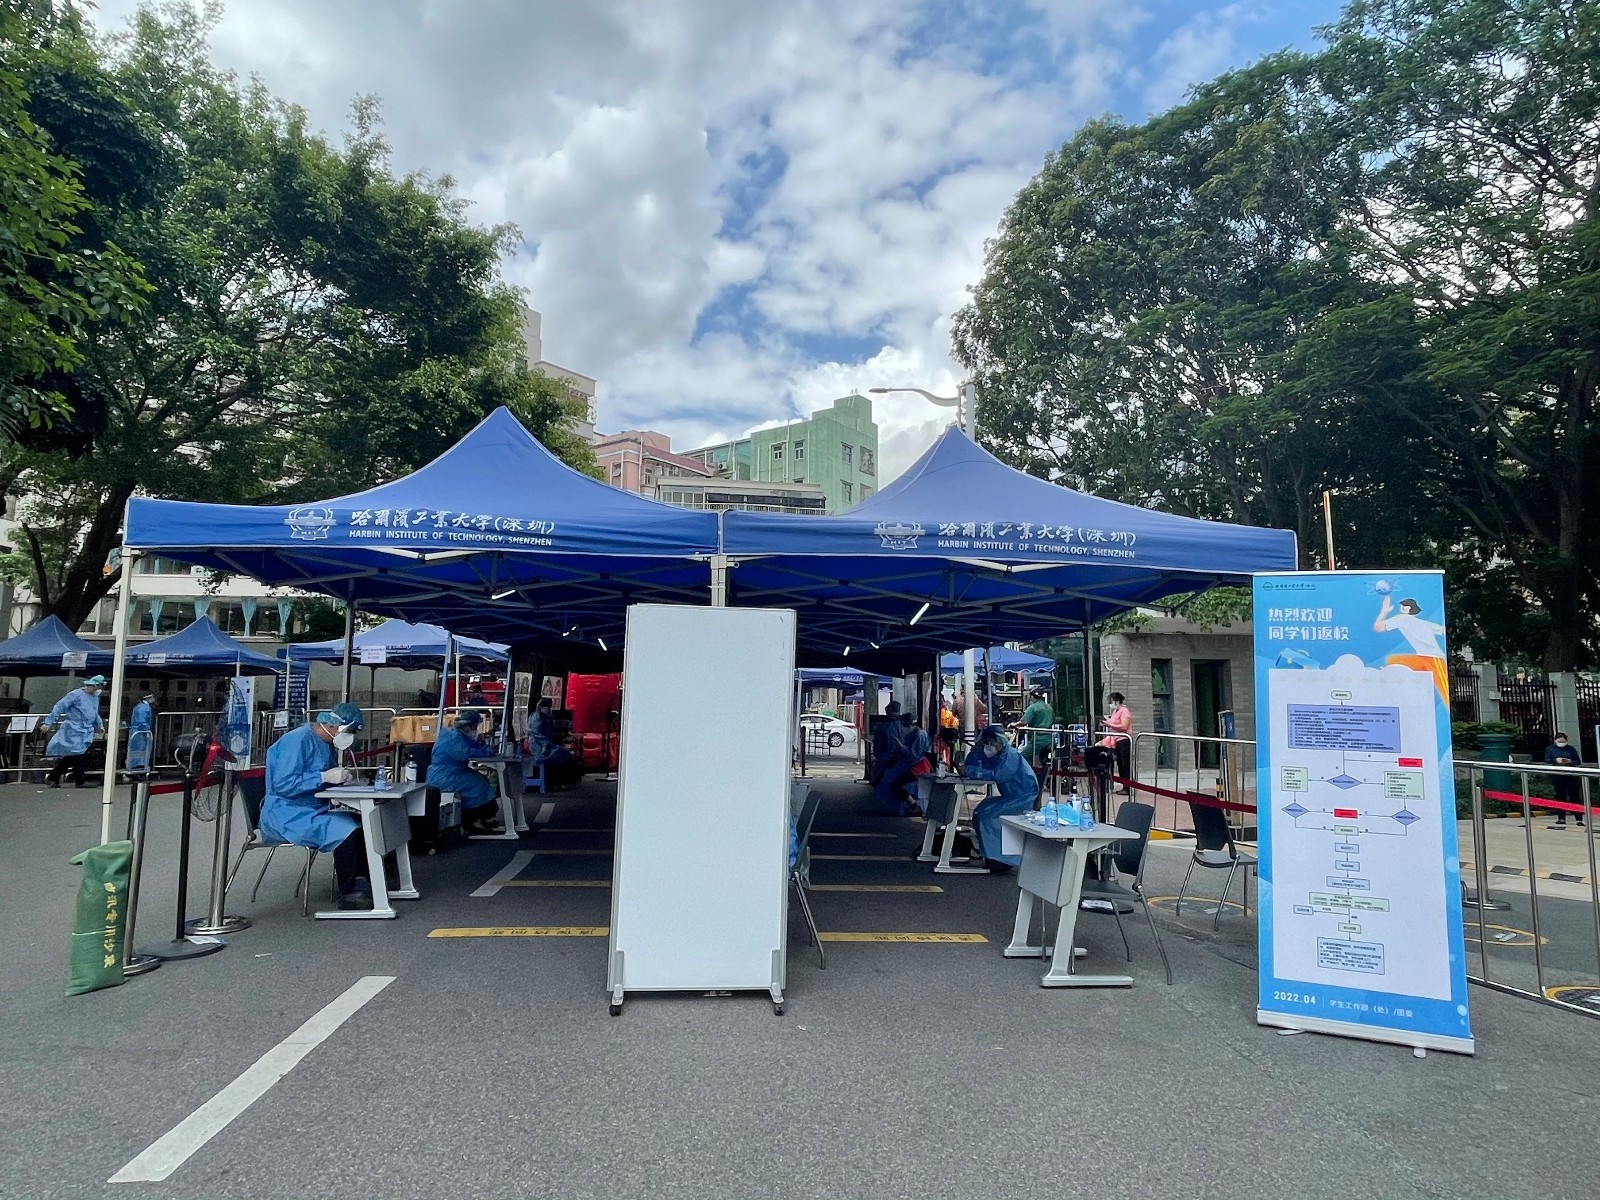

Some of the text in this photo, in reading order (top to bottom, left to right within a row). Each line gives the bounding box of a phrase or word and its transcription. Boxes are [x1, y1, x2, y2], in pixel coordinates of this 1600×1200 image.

[349, 529, 552, 546] HARBIN INSTITUTE OF TECHNOLOGY, SHENZHEN
[937, 540, 1136, 559] HARBIN INSTITUTE OF TECHNOLOGY, SHENZHEN
[1268, 607, 1333, 623] 热烈欢迎
[1268, 626, 1350, 641] 同学们返校
[1273, 990, 1316, 1006] 2022.04
